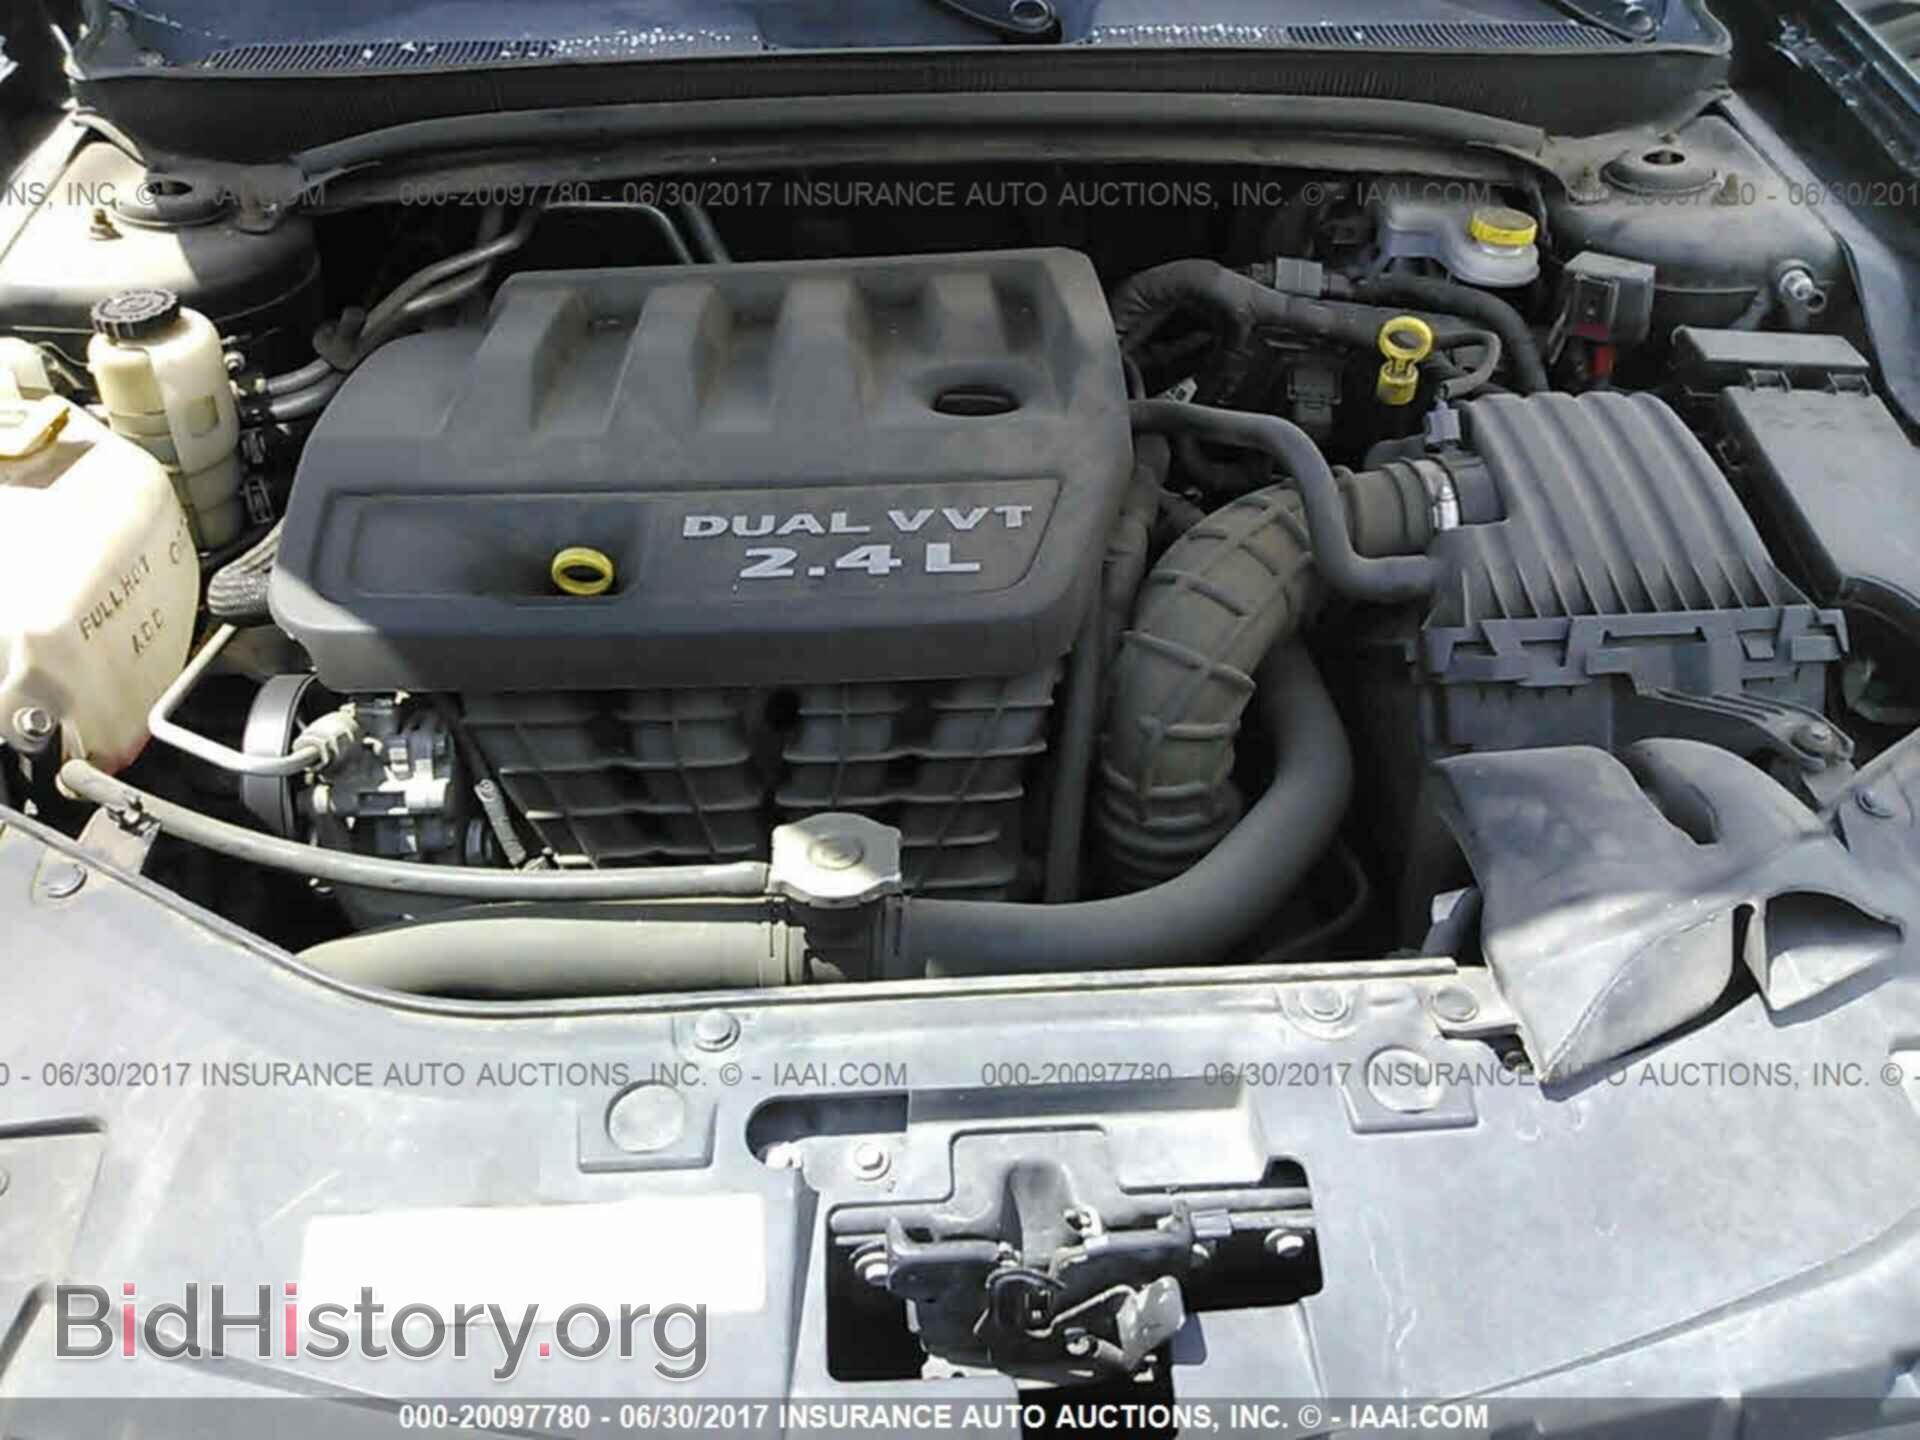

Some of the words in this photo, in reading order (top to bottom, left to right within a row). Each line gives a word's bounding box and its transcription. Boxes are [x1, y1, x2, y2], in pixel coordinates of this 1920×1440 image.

[682, 511, 872, 538] DUAL
[887, 505, 1033, 532] VVT
[79, 590, 123, 641] FULL
